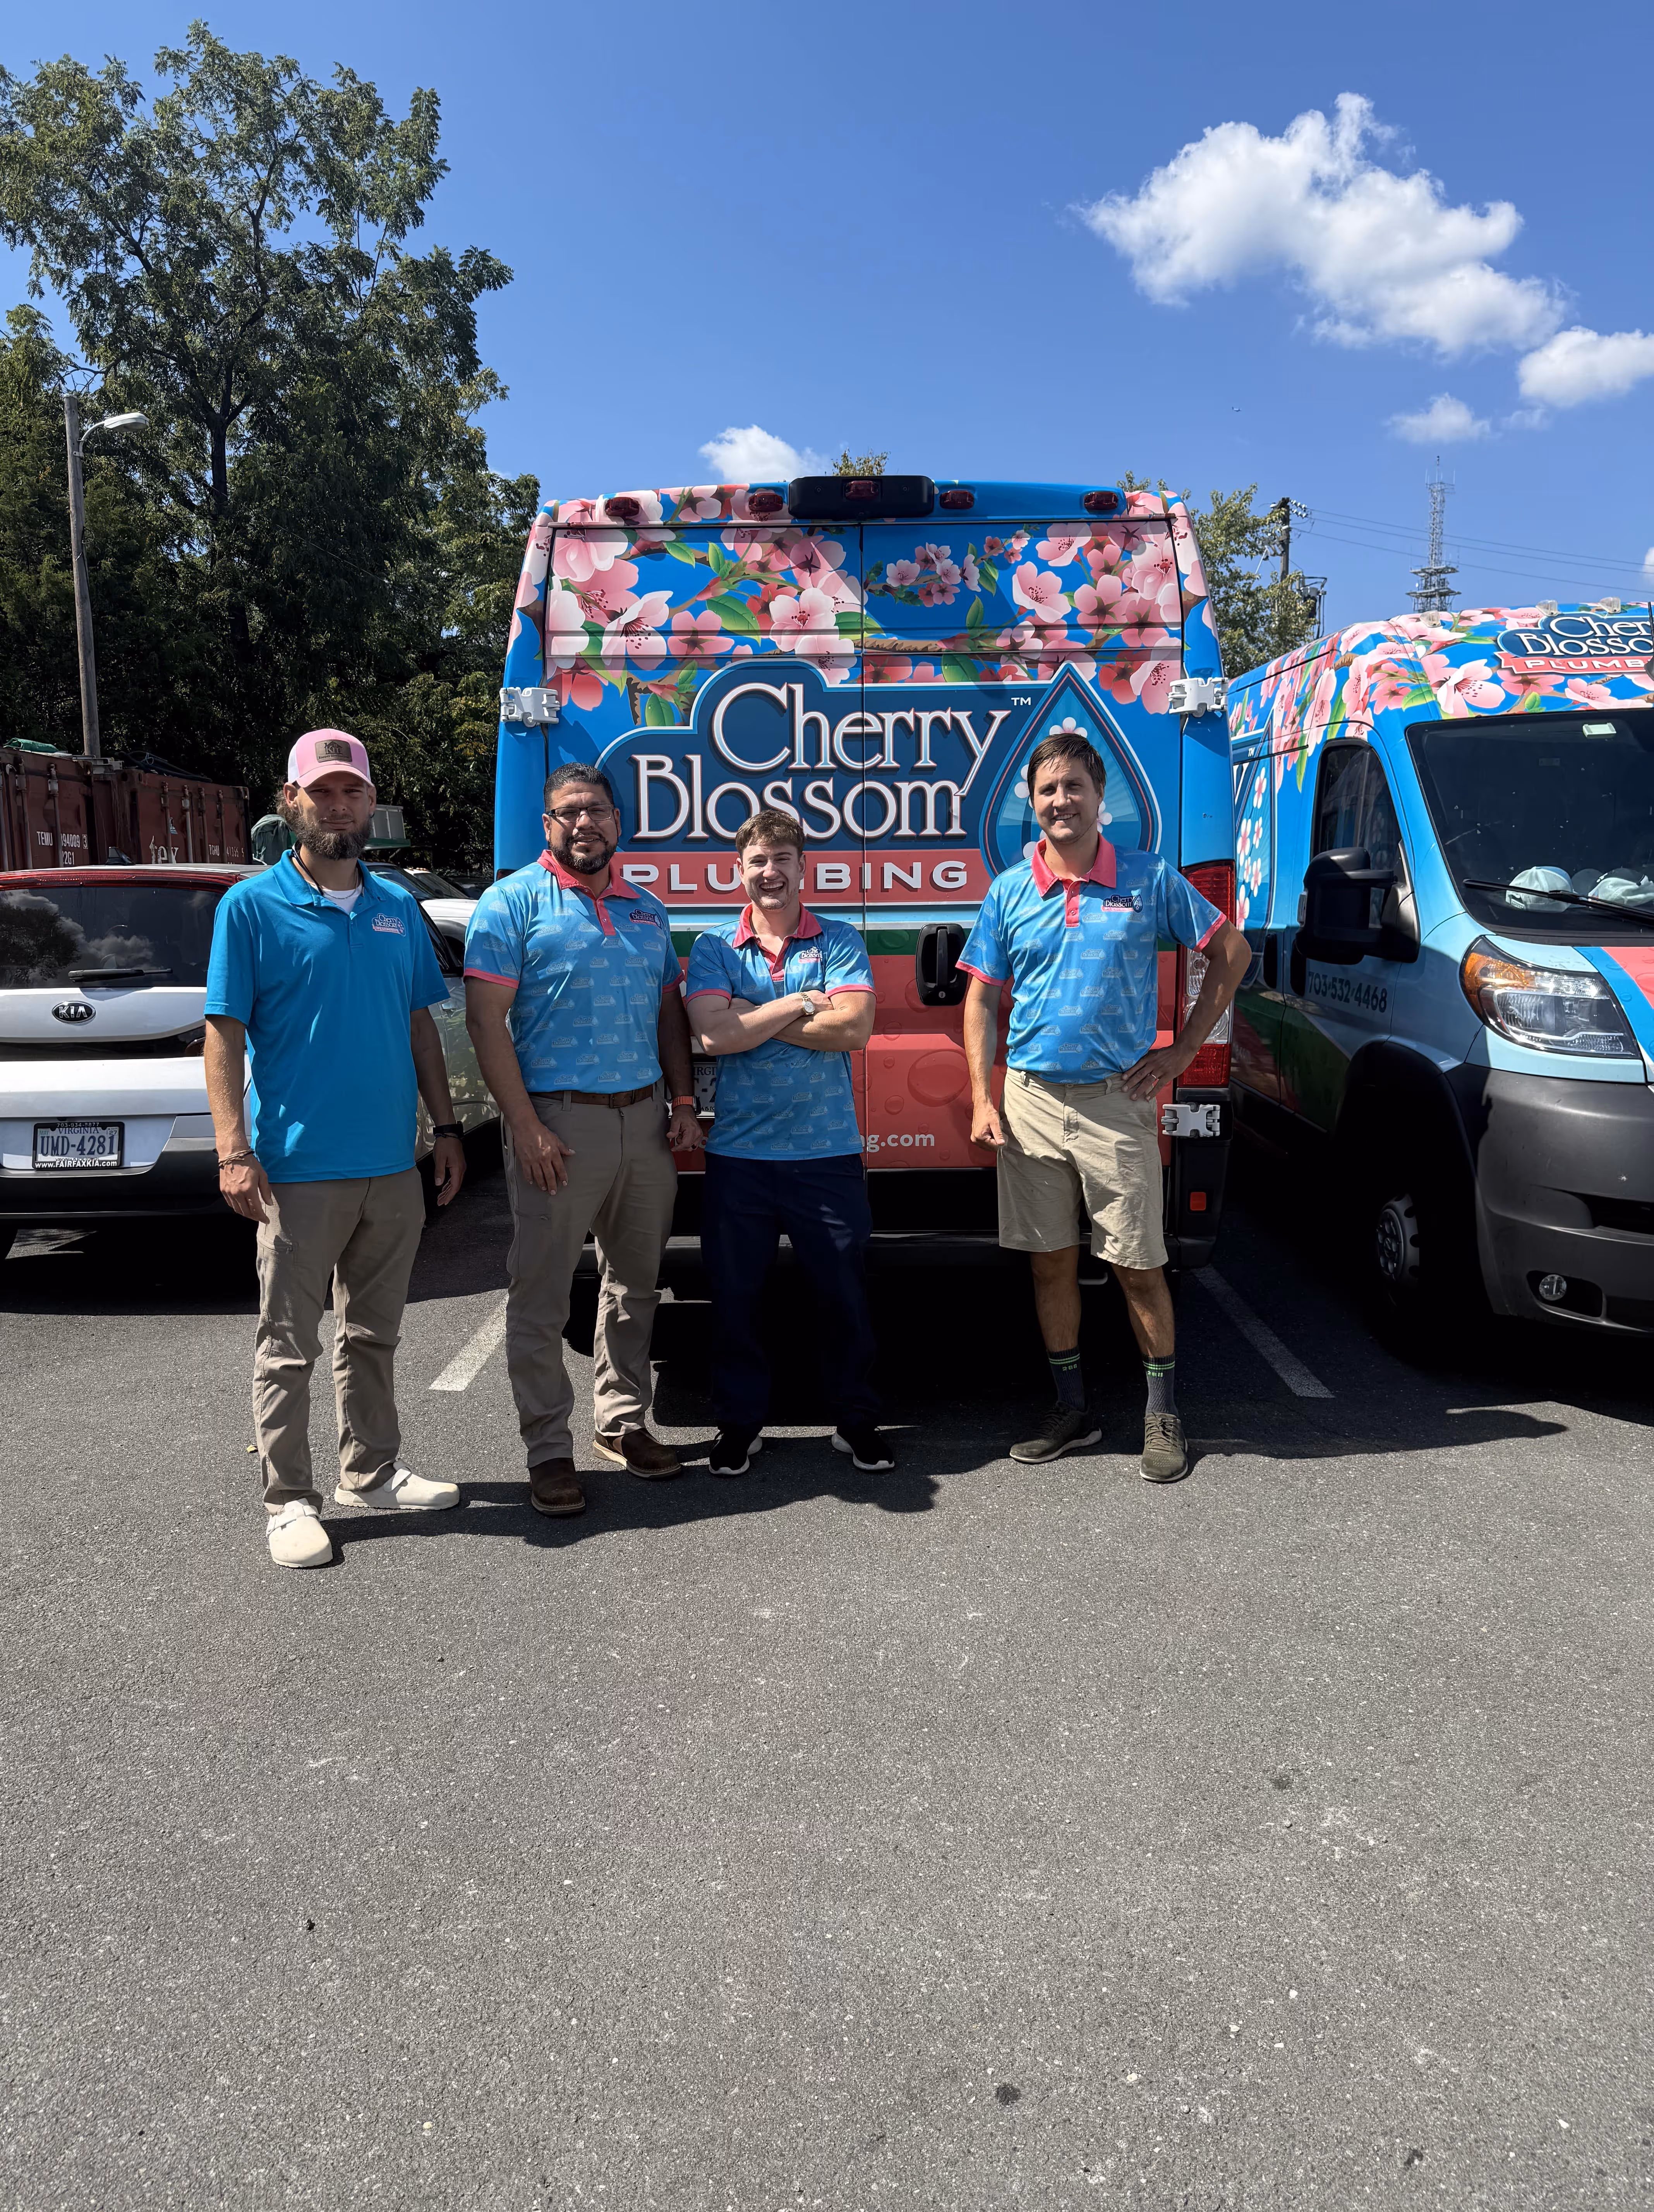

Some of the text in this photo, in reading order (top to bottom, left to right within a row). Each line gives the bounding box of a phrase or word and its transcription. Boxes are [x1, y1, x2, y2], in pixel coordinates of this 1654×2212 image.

[1549, 616, 1652, 637] Cher
[1525, 659, 1650, 669] PLUMB
[712, 682, 1012, 797] Cherry
[630, 754, 968, 839] Blossom
[36, 831, 53, 846] TEMU
[83, 835, 88, 849] 3
[622, 860, 968, 891] PLUBING
[59, 1006, 88, 1018] KIA
[41, 1135, 115, 1157] UMD-4281
[35, 1160, 117, 1168] www.FAIRFAXKIA.com
